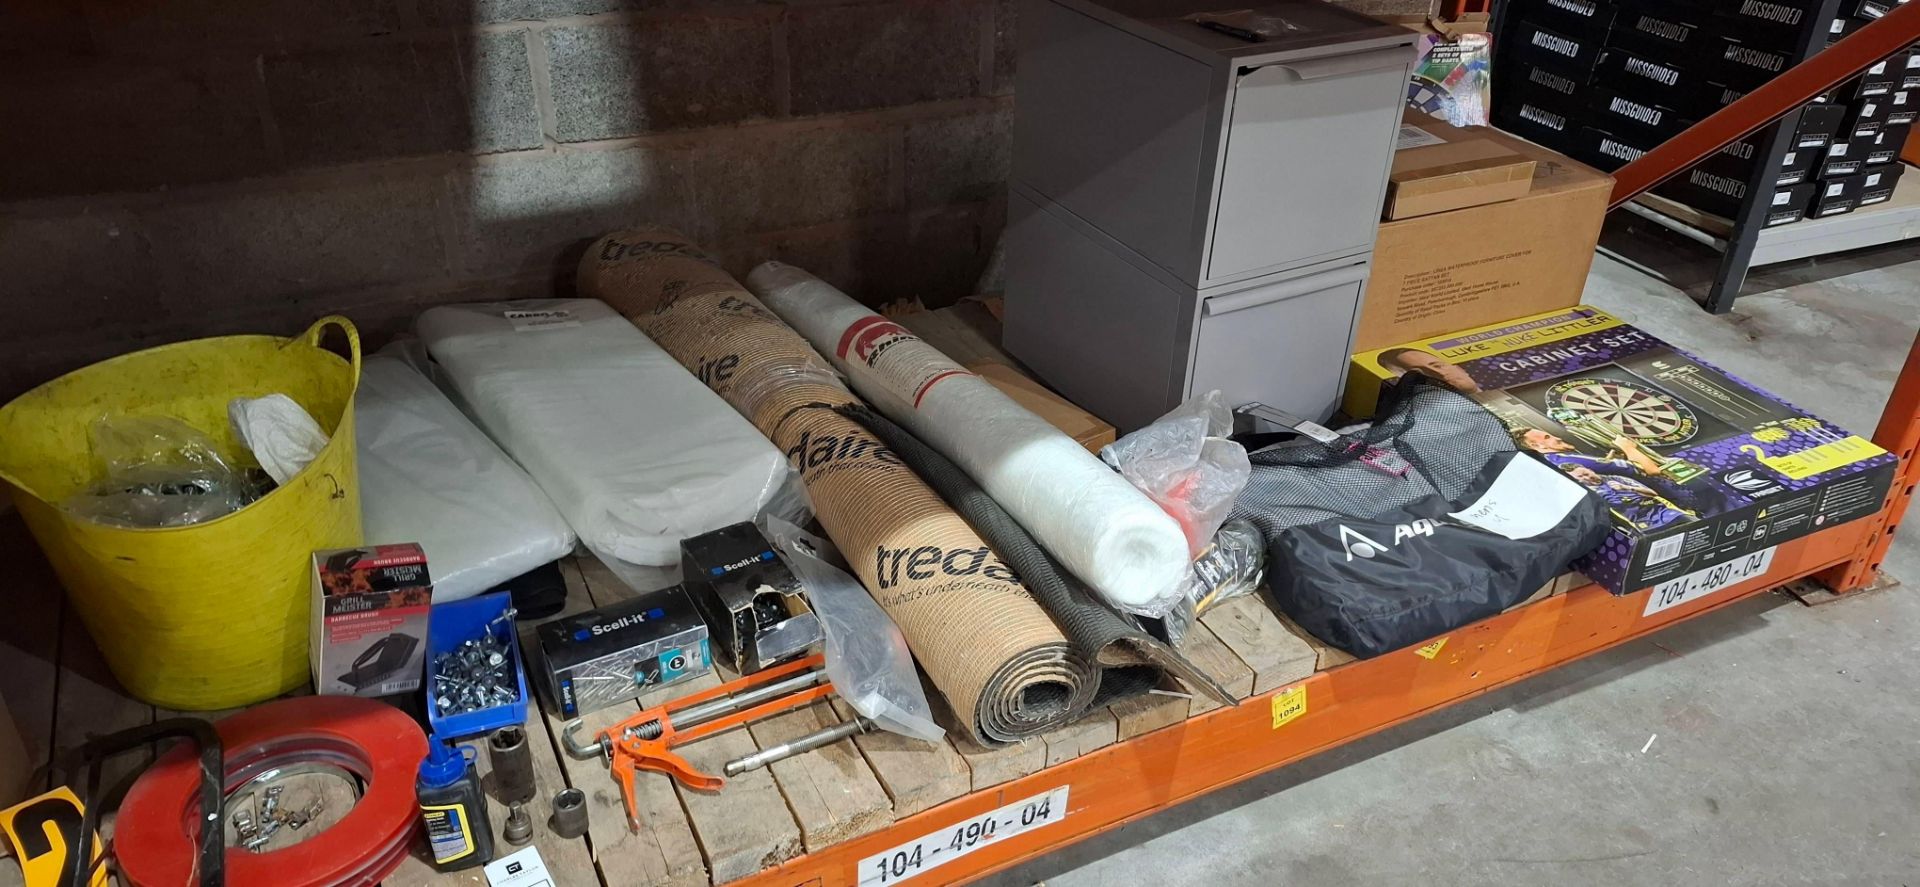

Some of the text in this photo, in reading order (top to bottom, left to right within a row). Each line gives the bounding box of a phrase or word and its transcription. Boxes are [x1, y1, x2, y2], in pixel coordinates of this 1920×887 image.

[1739, 0, 1803, 25] MISSGUIDED
[1636, 15, 1689, 42] MISSGUIDED
[1531, 30, 1579, 58] MISSGUIDED
[1724, 44, 1786, 72] MISSGUIDED
[1528, 66, 1576, 95] MISSGUIDED
[1624, 57, 1679, 86] MISSGUIDED
[1519, 103, 1566, 131] MISSGUIDED
[1609, 96, 1662, 126] MISSGUIDED
[1690, 169, 1747, 199] MISSGUIDED
[1441, 343, 1490, 358] LUKE
[1537, 315, 1612, 337] LITTLER
[1456, 314, 1572, 344] WORLD CHAMPION
[1500, 331, 1645, 372] CABINET SET
[383, 564, 423, 577] MEISTER
[394, 573, 416, 582] GRILL
[1659, 582, 1687, 608] 104
[1701, 562, 1731, 591] 480
[1742, 551, 1766, 578] 04
[332, 600, 372, 614] MEISTER
[341, 596, 363, 605] GRILL
[591, 612, 645, 637] Scell-it
[1279, 703, 1300, 720] 1094
[876, 843, 924, 883] 104
[1021, 796, 1051, 827] 04
